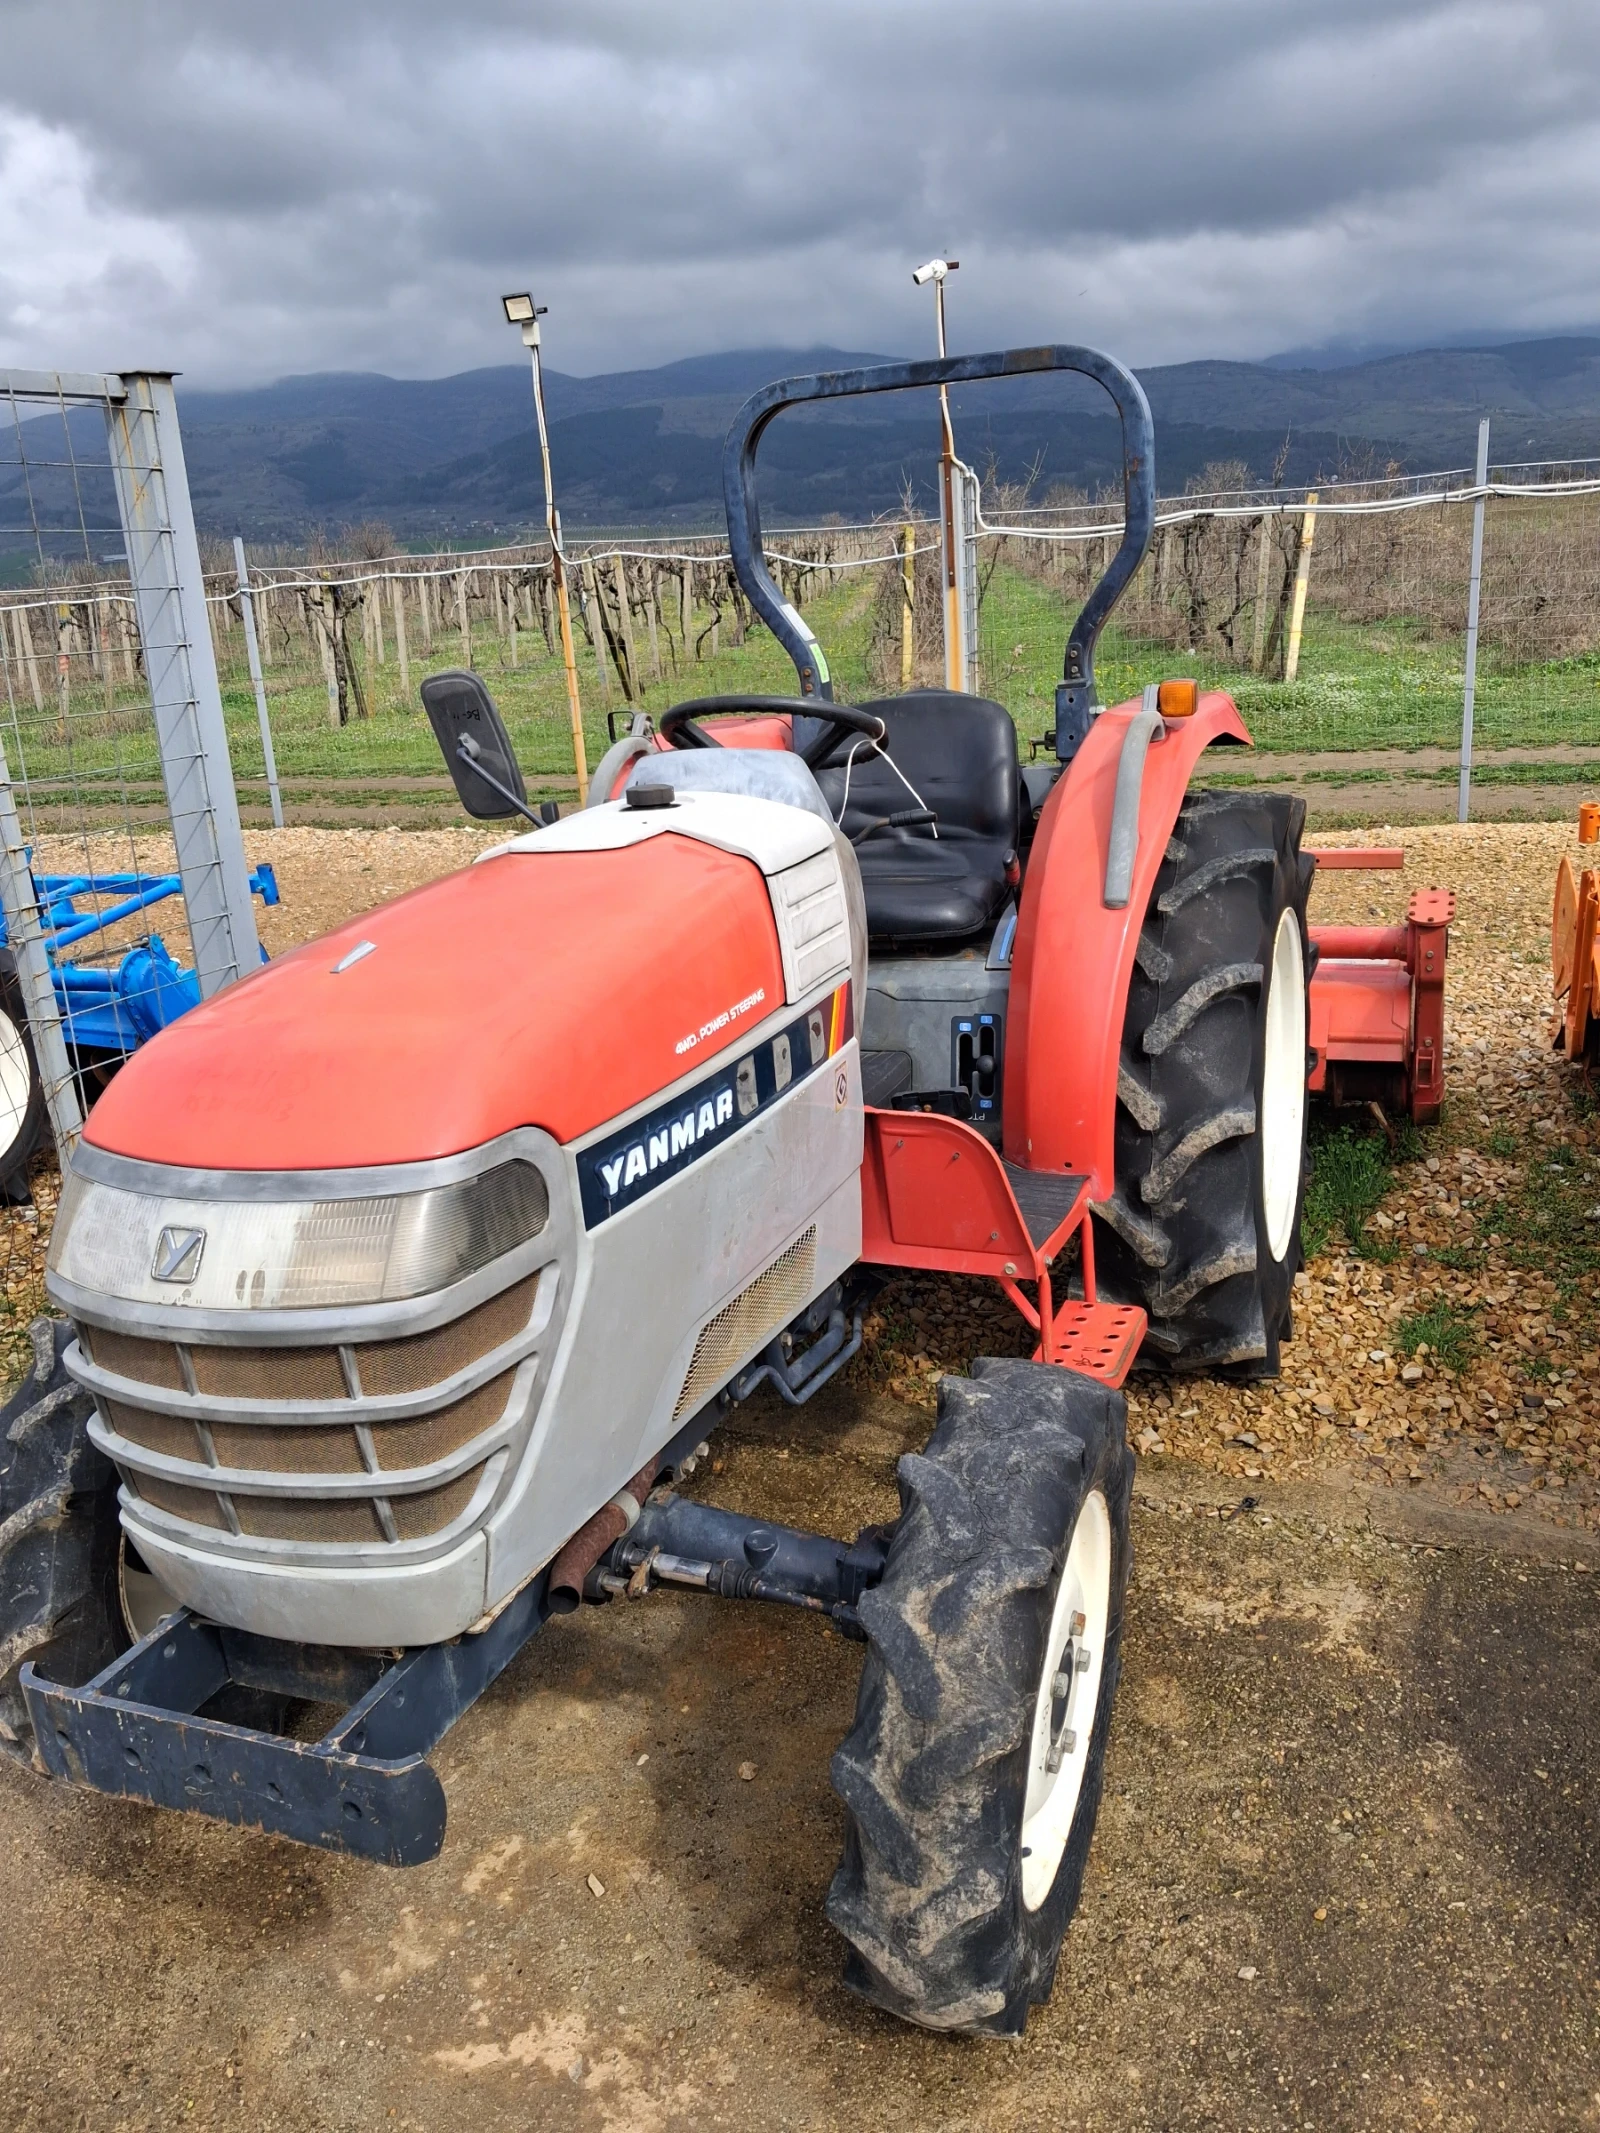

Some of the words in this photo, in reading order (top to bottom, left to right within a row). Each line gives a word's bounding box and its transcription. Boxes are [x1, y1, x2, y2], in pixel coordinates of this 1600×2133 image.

[699, 1011, 731, 1041] POWER
[729, 987, 765, 1020] STEERING
[601, 1089, 733, 1196] YANMAR
[968, 1113, 985, 1121] PT
